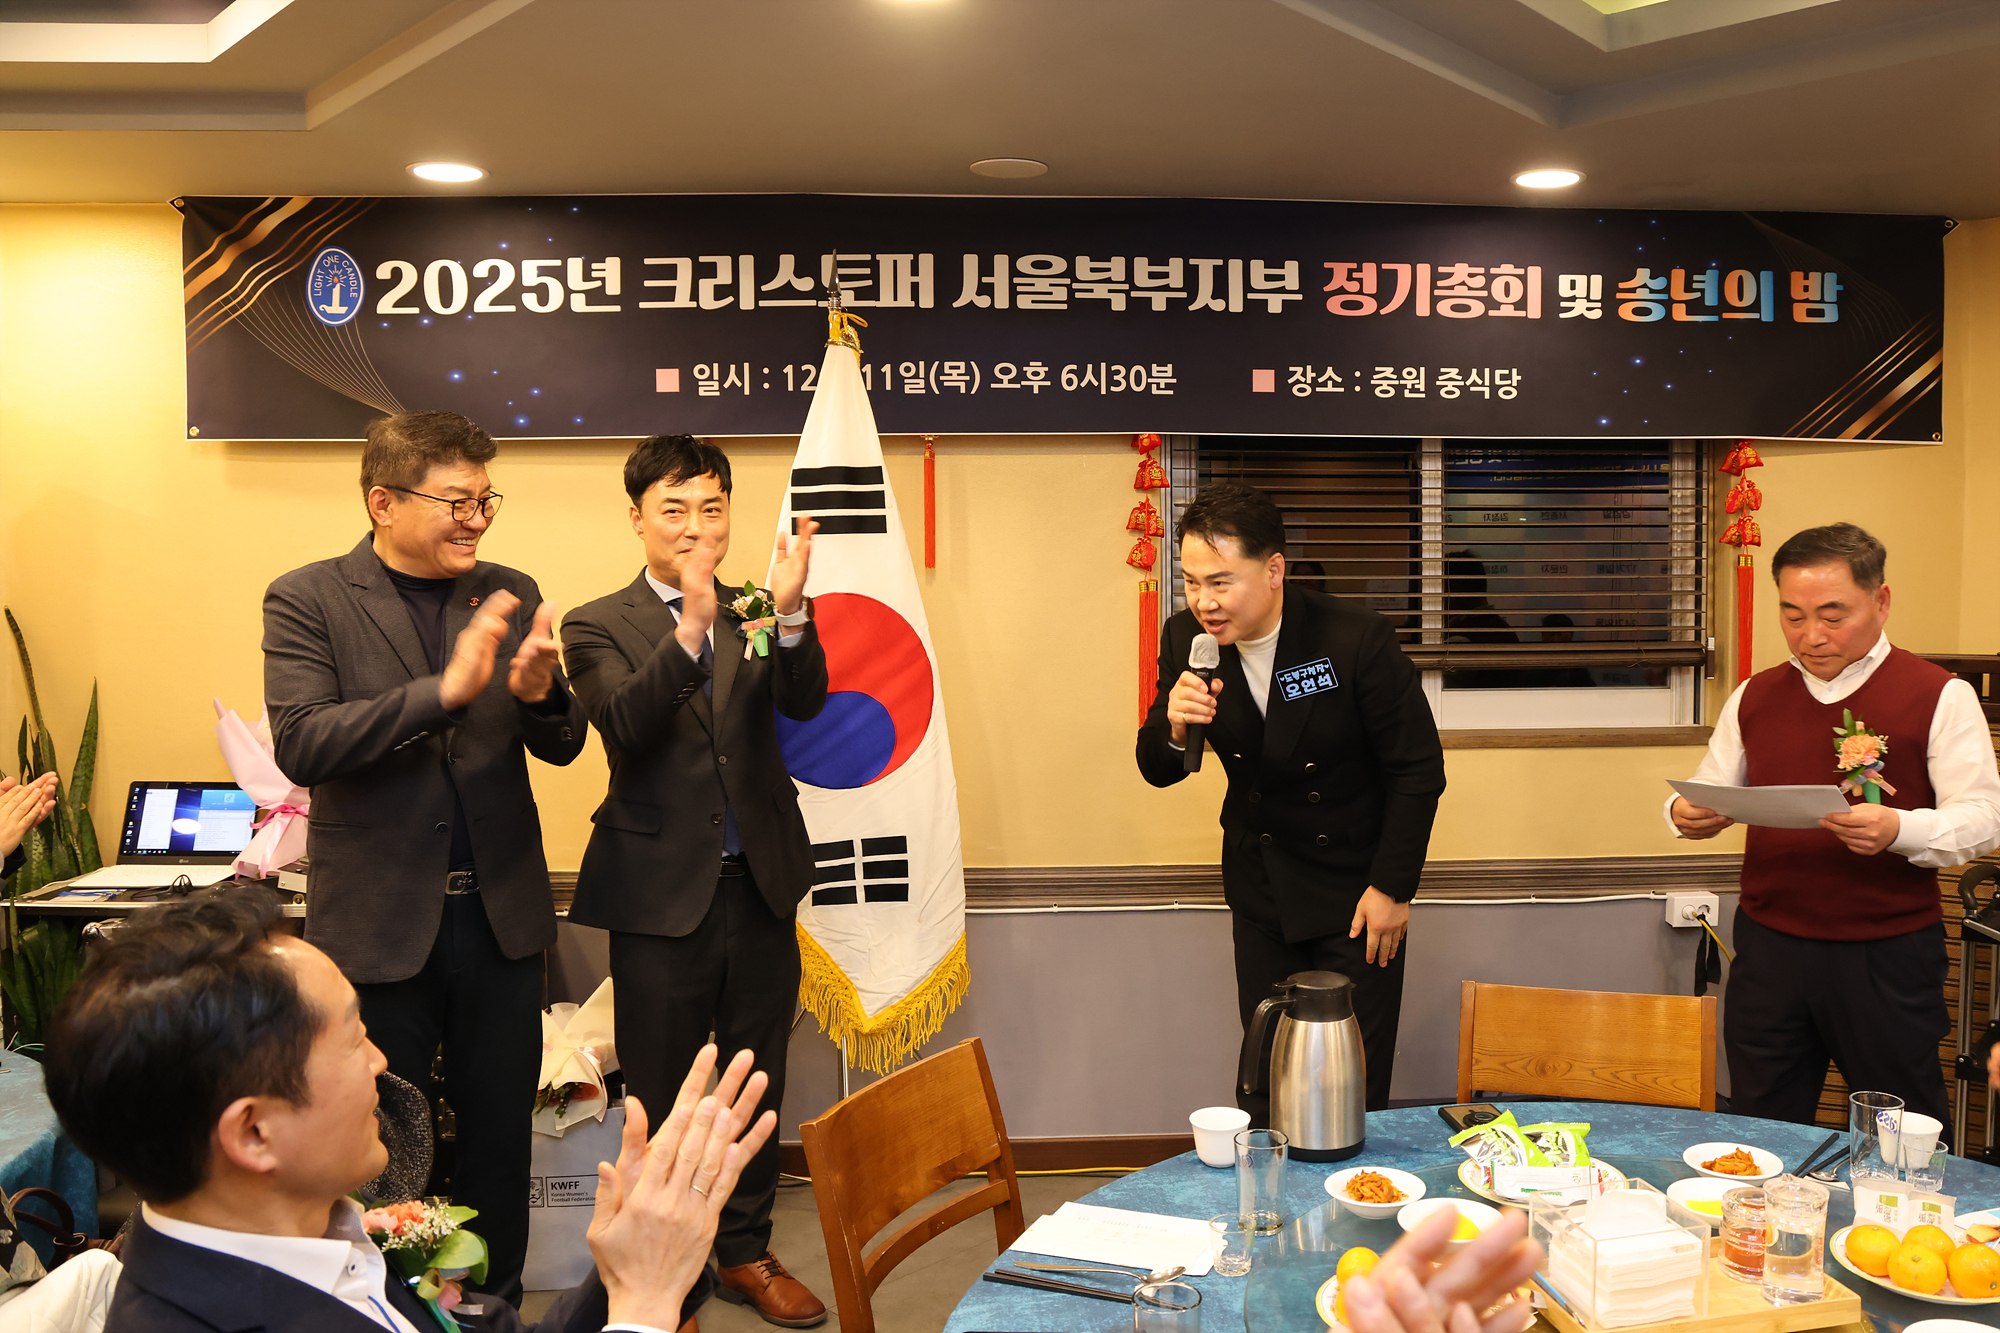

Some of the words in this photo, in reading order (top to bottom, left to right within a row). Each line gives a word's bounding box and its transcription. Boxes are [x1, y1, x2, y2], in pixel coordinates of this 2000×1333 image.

[314, 268, 325, 296] LIGHT
[323, 255, 340, 267] ONE
[342, 260, 358, 298] CANDLE
[375, 256, 621, 315] 2025년
[638, 253, 934, 311] 크리스토퍼
[952, 253, 1303, 314] 서울북부지부
[1323, 261, 1543, 320] 정기총회
[1558, 274, 1603, 319] 및
[1615, 267, 1775, 322] 송년의
[1790, 270, 1844, 323] 밤
[693, 362, 750, 396] 일시
[782, 363, 817, 392] 12
[861, 360, 981, 395] 11일(목)
[990, 361, 1051, 394] 오후
[1060, 361, 1178, 396] 6시30분
[1287, 365, 1346, 397] 장소
[1370, 366, 1427, 399] 중원
[1436, 367, 1522, 400] 중식당
[1284, 663, 1325, 683] 도봉구청장
[1285, 673, 1333, 697] 오언석
[551, 1181, 580, 1190] KWFF
